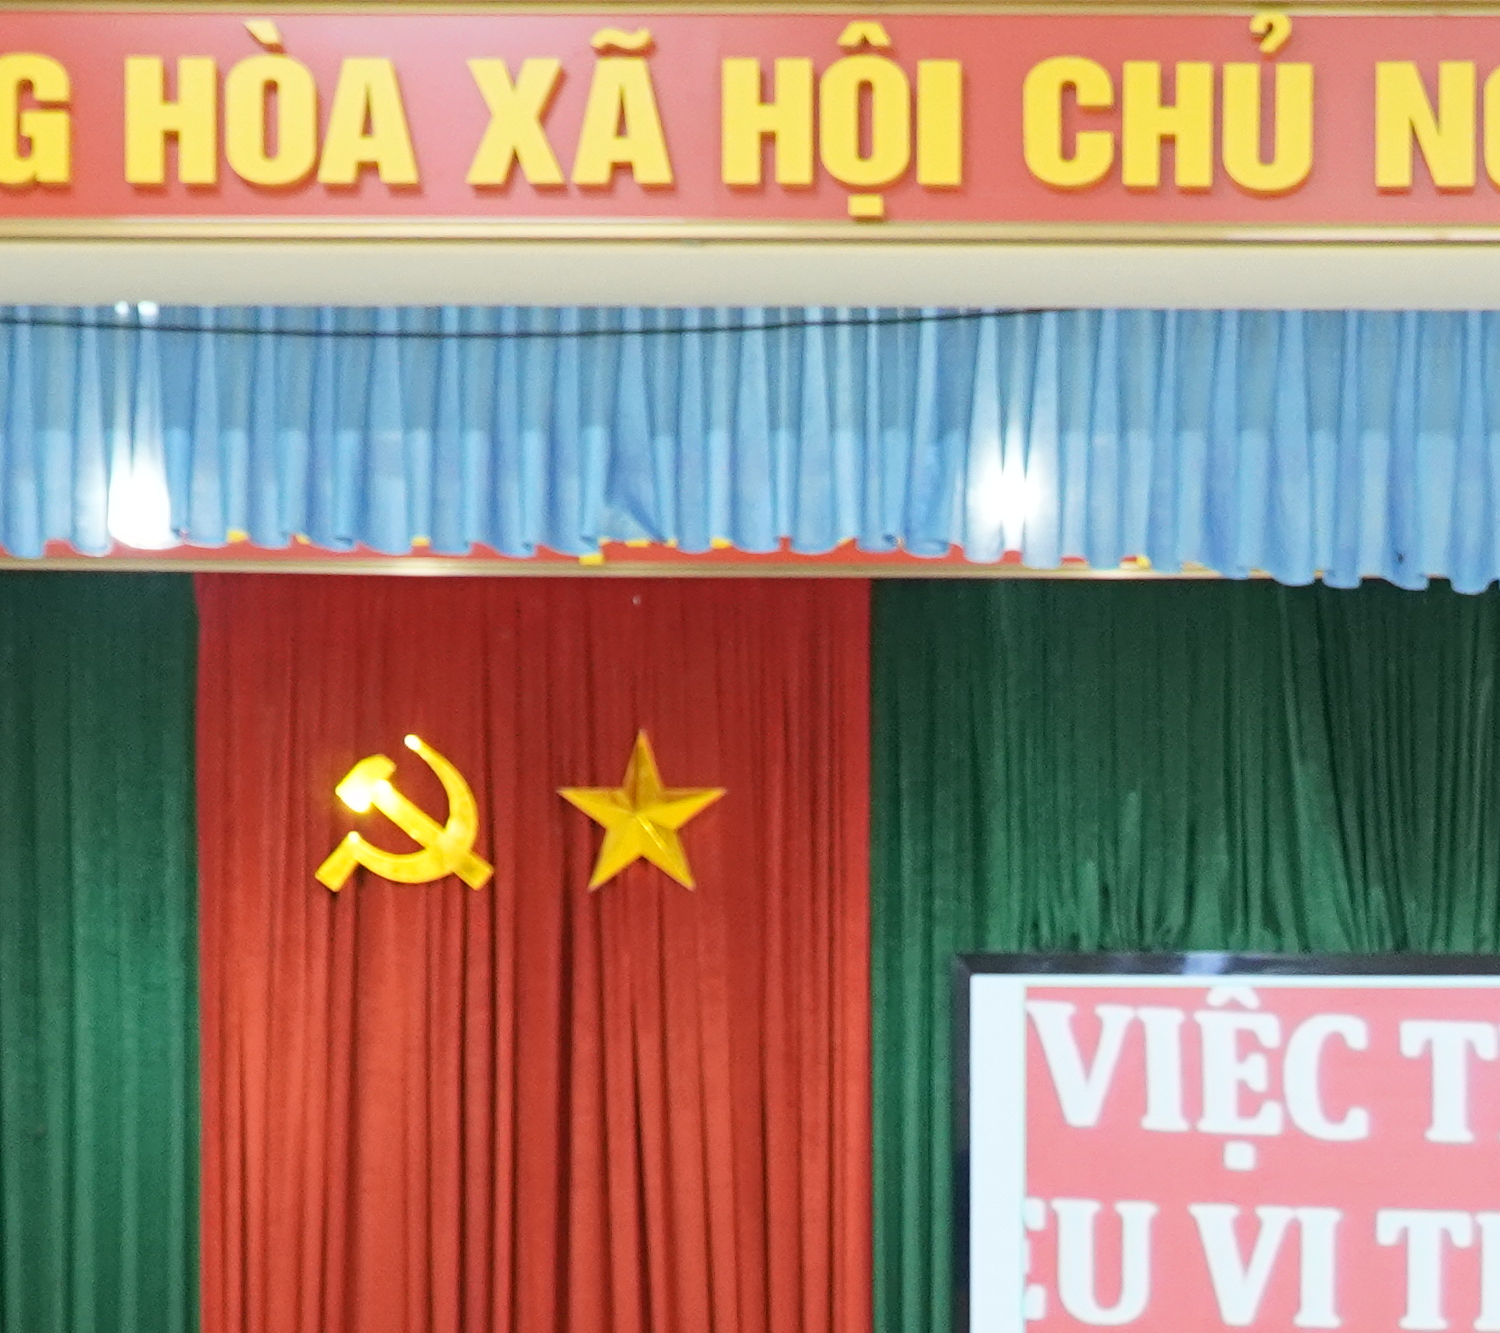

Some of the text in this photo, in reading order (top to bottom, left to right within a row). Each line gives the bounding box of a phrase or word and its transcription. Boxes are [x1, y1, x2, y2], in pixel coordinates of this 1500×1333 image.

[124, 18, 420, 187] HÒA
[467, 28, 674, 187] XÃ
[721, 20, 965, 218] HỘI
[1022, 11, 1315, 193] CHỦ
[1026, 987, 1370, 1172] VIỆC
[1024, 1197, 1159, 1326] U
